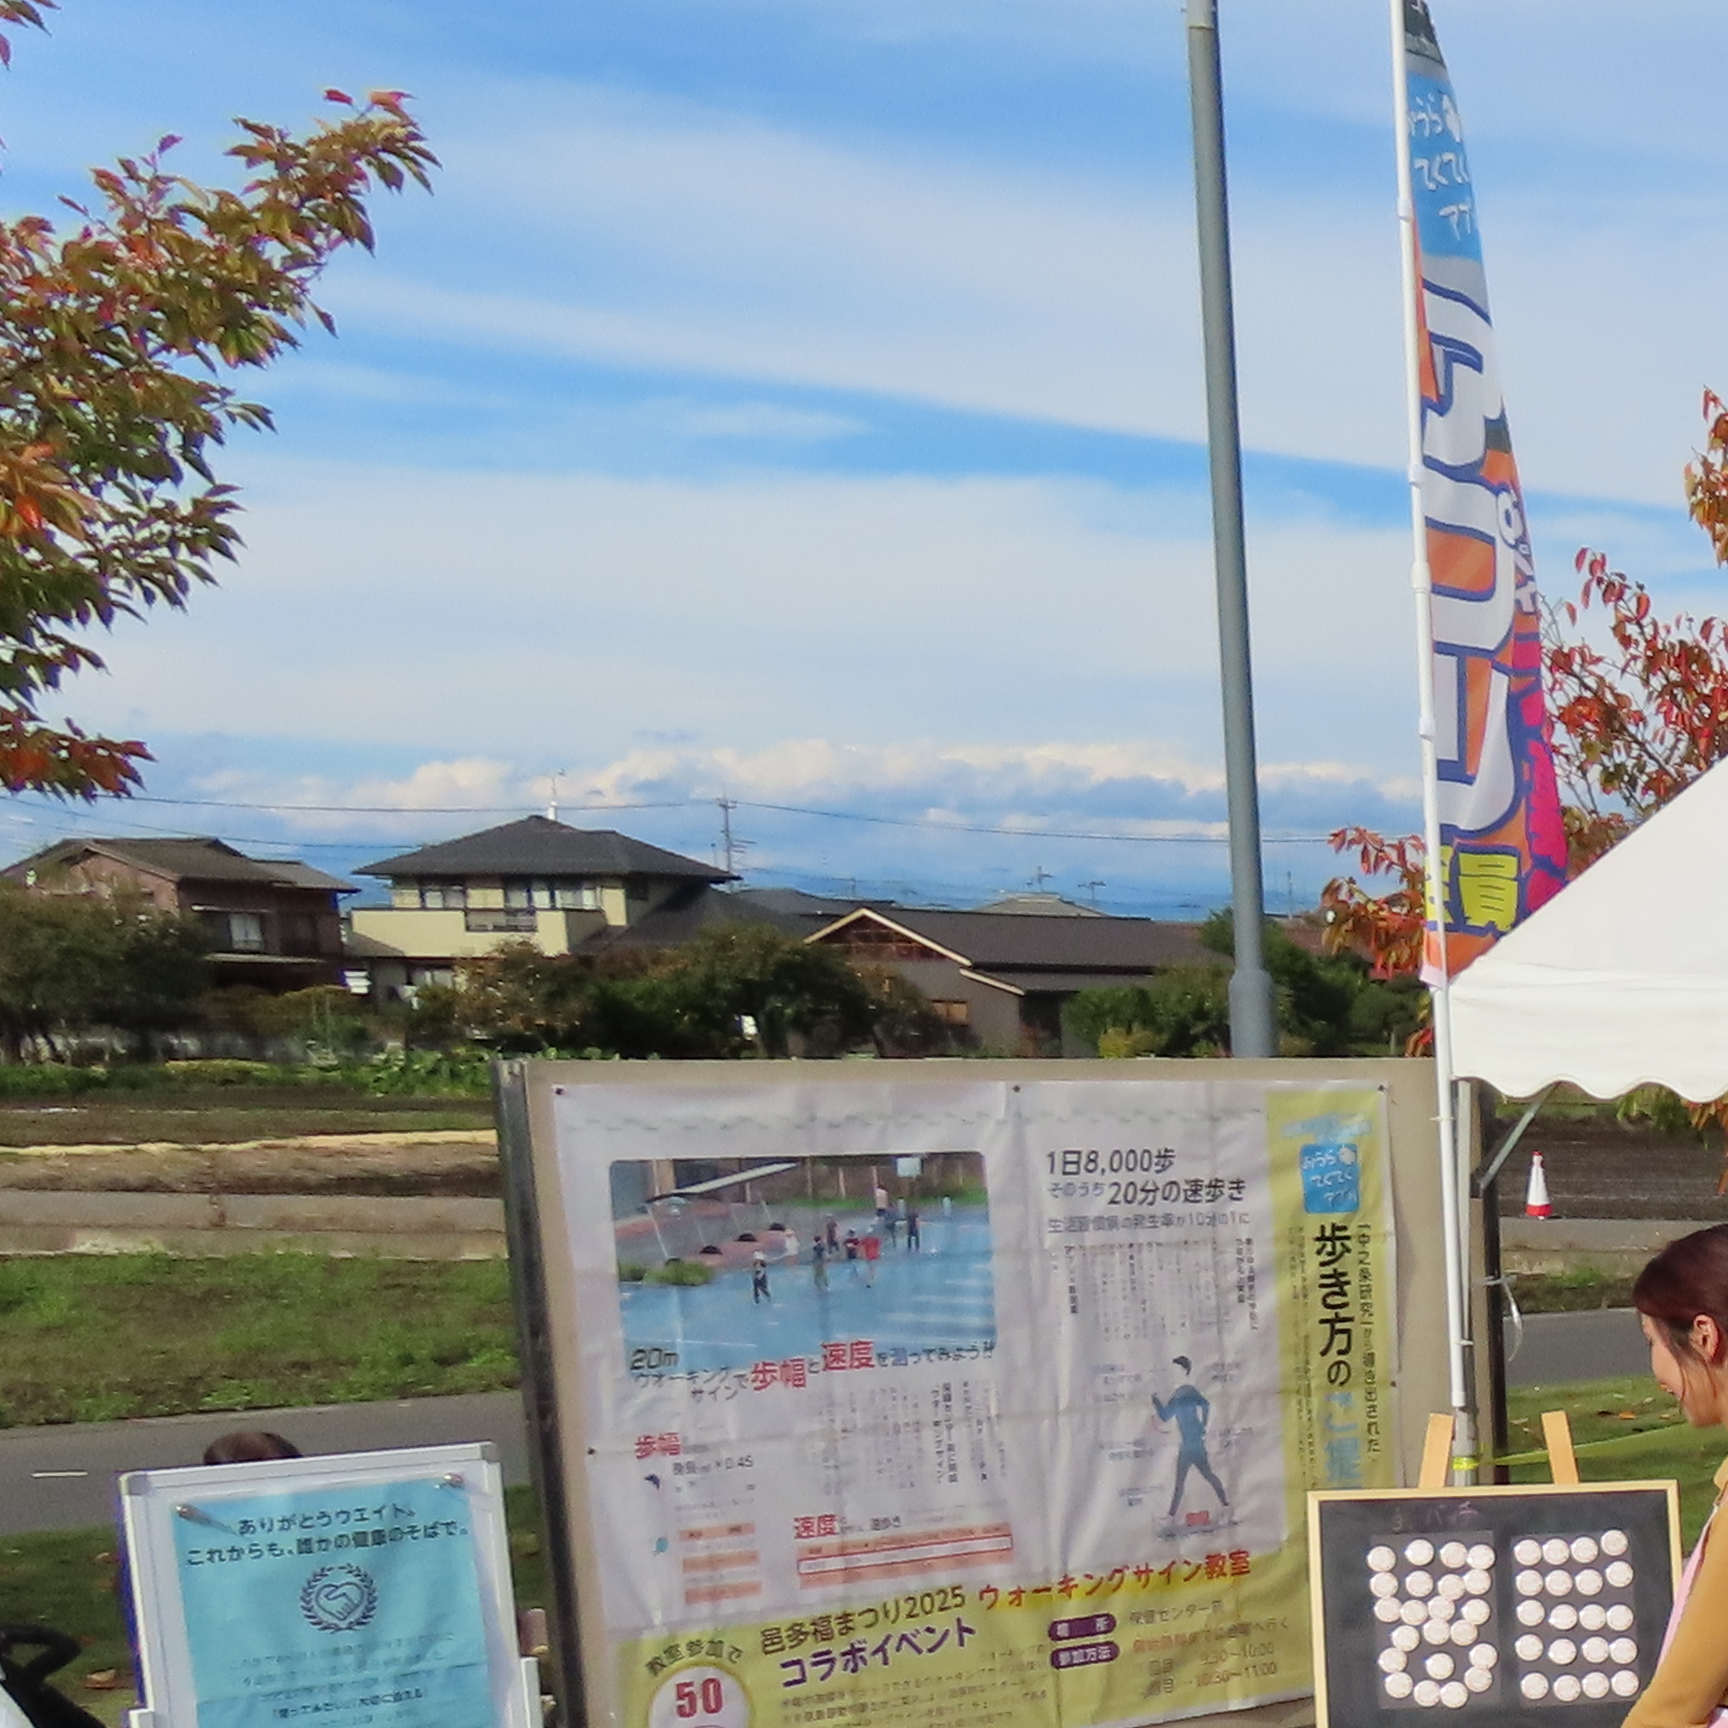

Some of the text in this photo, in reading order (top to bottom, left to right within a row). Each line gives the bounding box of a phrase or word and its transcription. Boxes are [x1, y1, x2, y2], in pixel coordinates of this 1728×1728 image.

[1047, 1147, 1176, 1176] 1日8,000歩
[760, 1584, 967, 1656] 邑多福まつり2025
[779, 1615, 979, 1688] コラボイベント
[675, 1677, 723, 1718] 50
